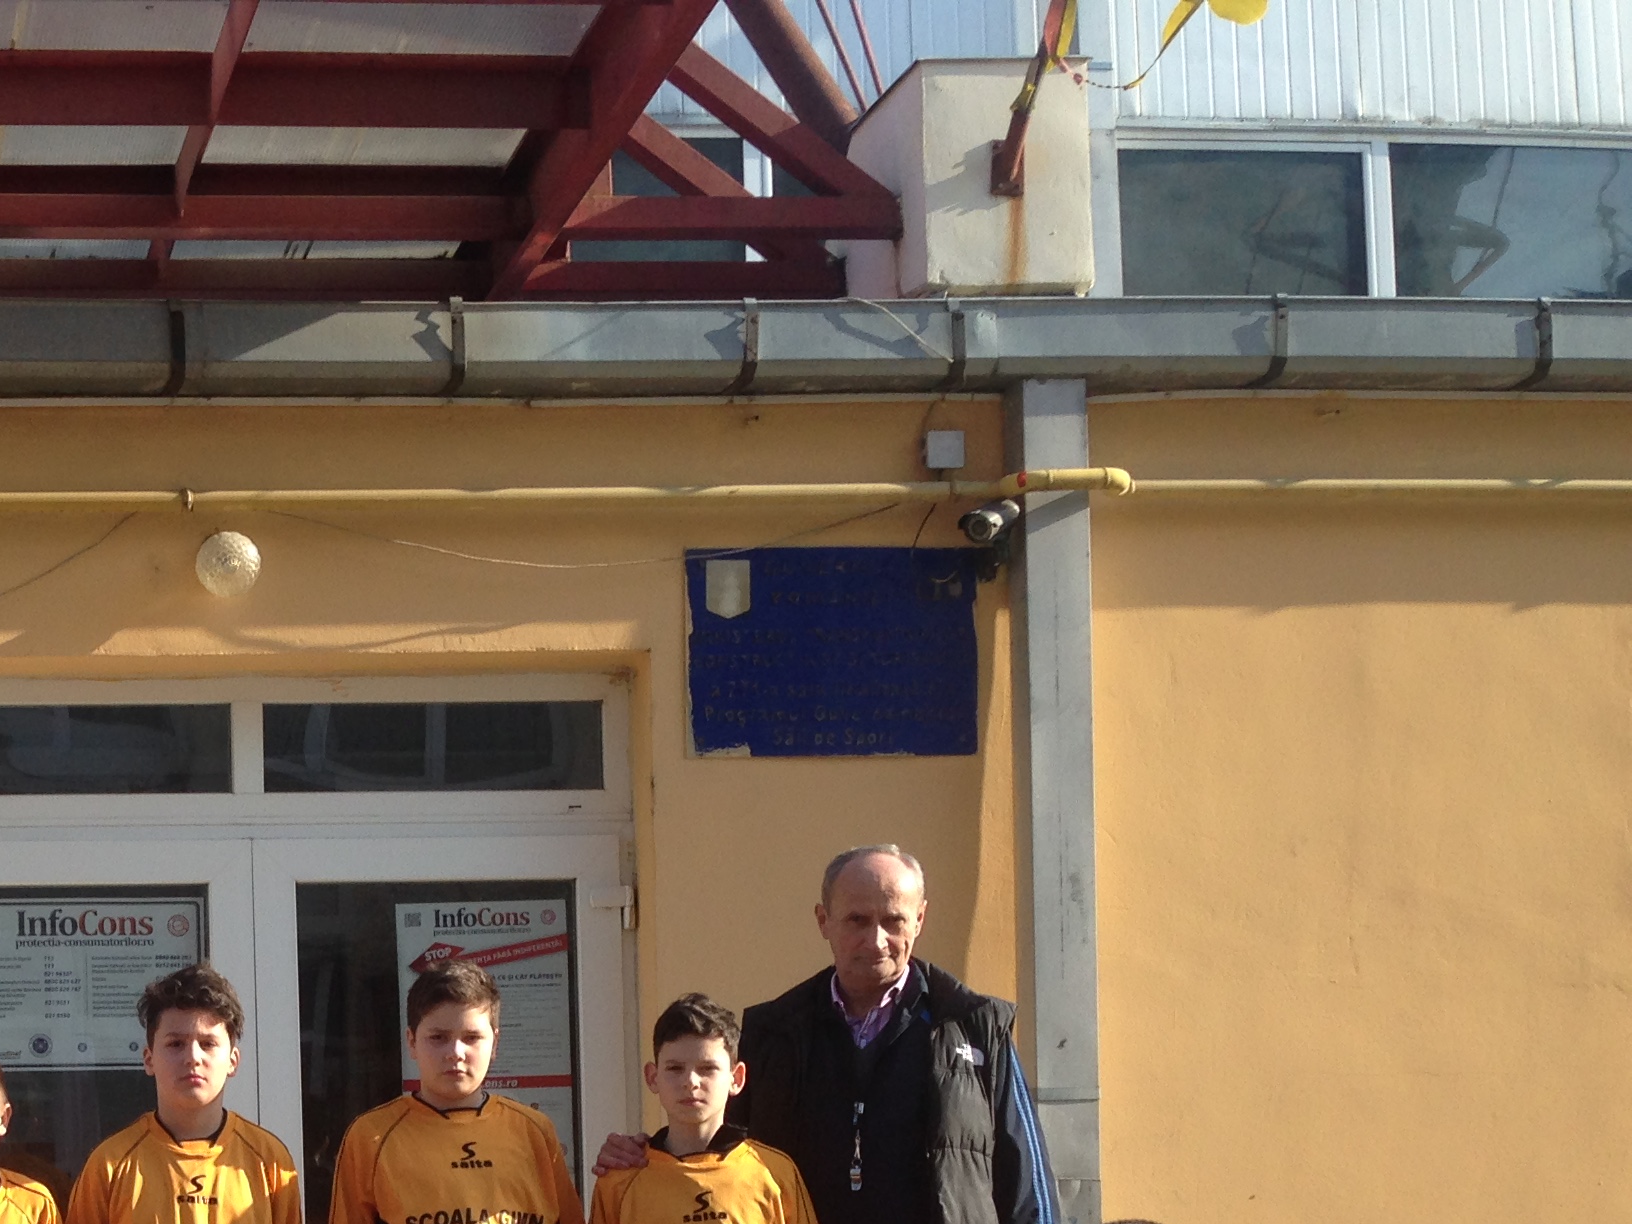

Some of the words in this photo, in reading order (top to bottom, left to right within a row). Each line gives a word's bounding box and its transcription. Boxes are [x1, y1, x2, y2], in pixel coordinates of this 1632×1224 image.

[16, 908, 154, 937] InfoCons
[434, 907, 530, 928] InfoCons
[424, 947, 452, 962] STOP
[451, 1159, 493, 1169] salta
[682, 1211, 727, 1223] salta
